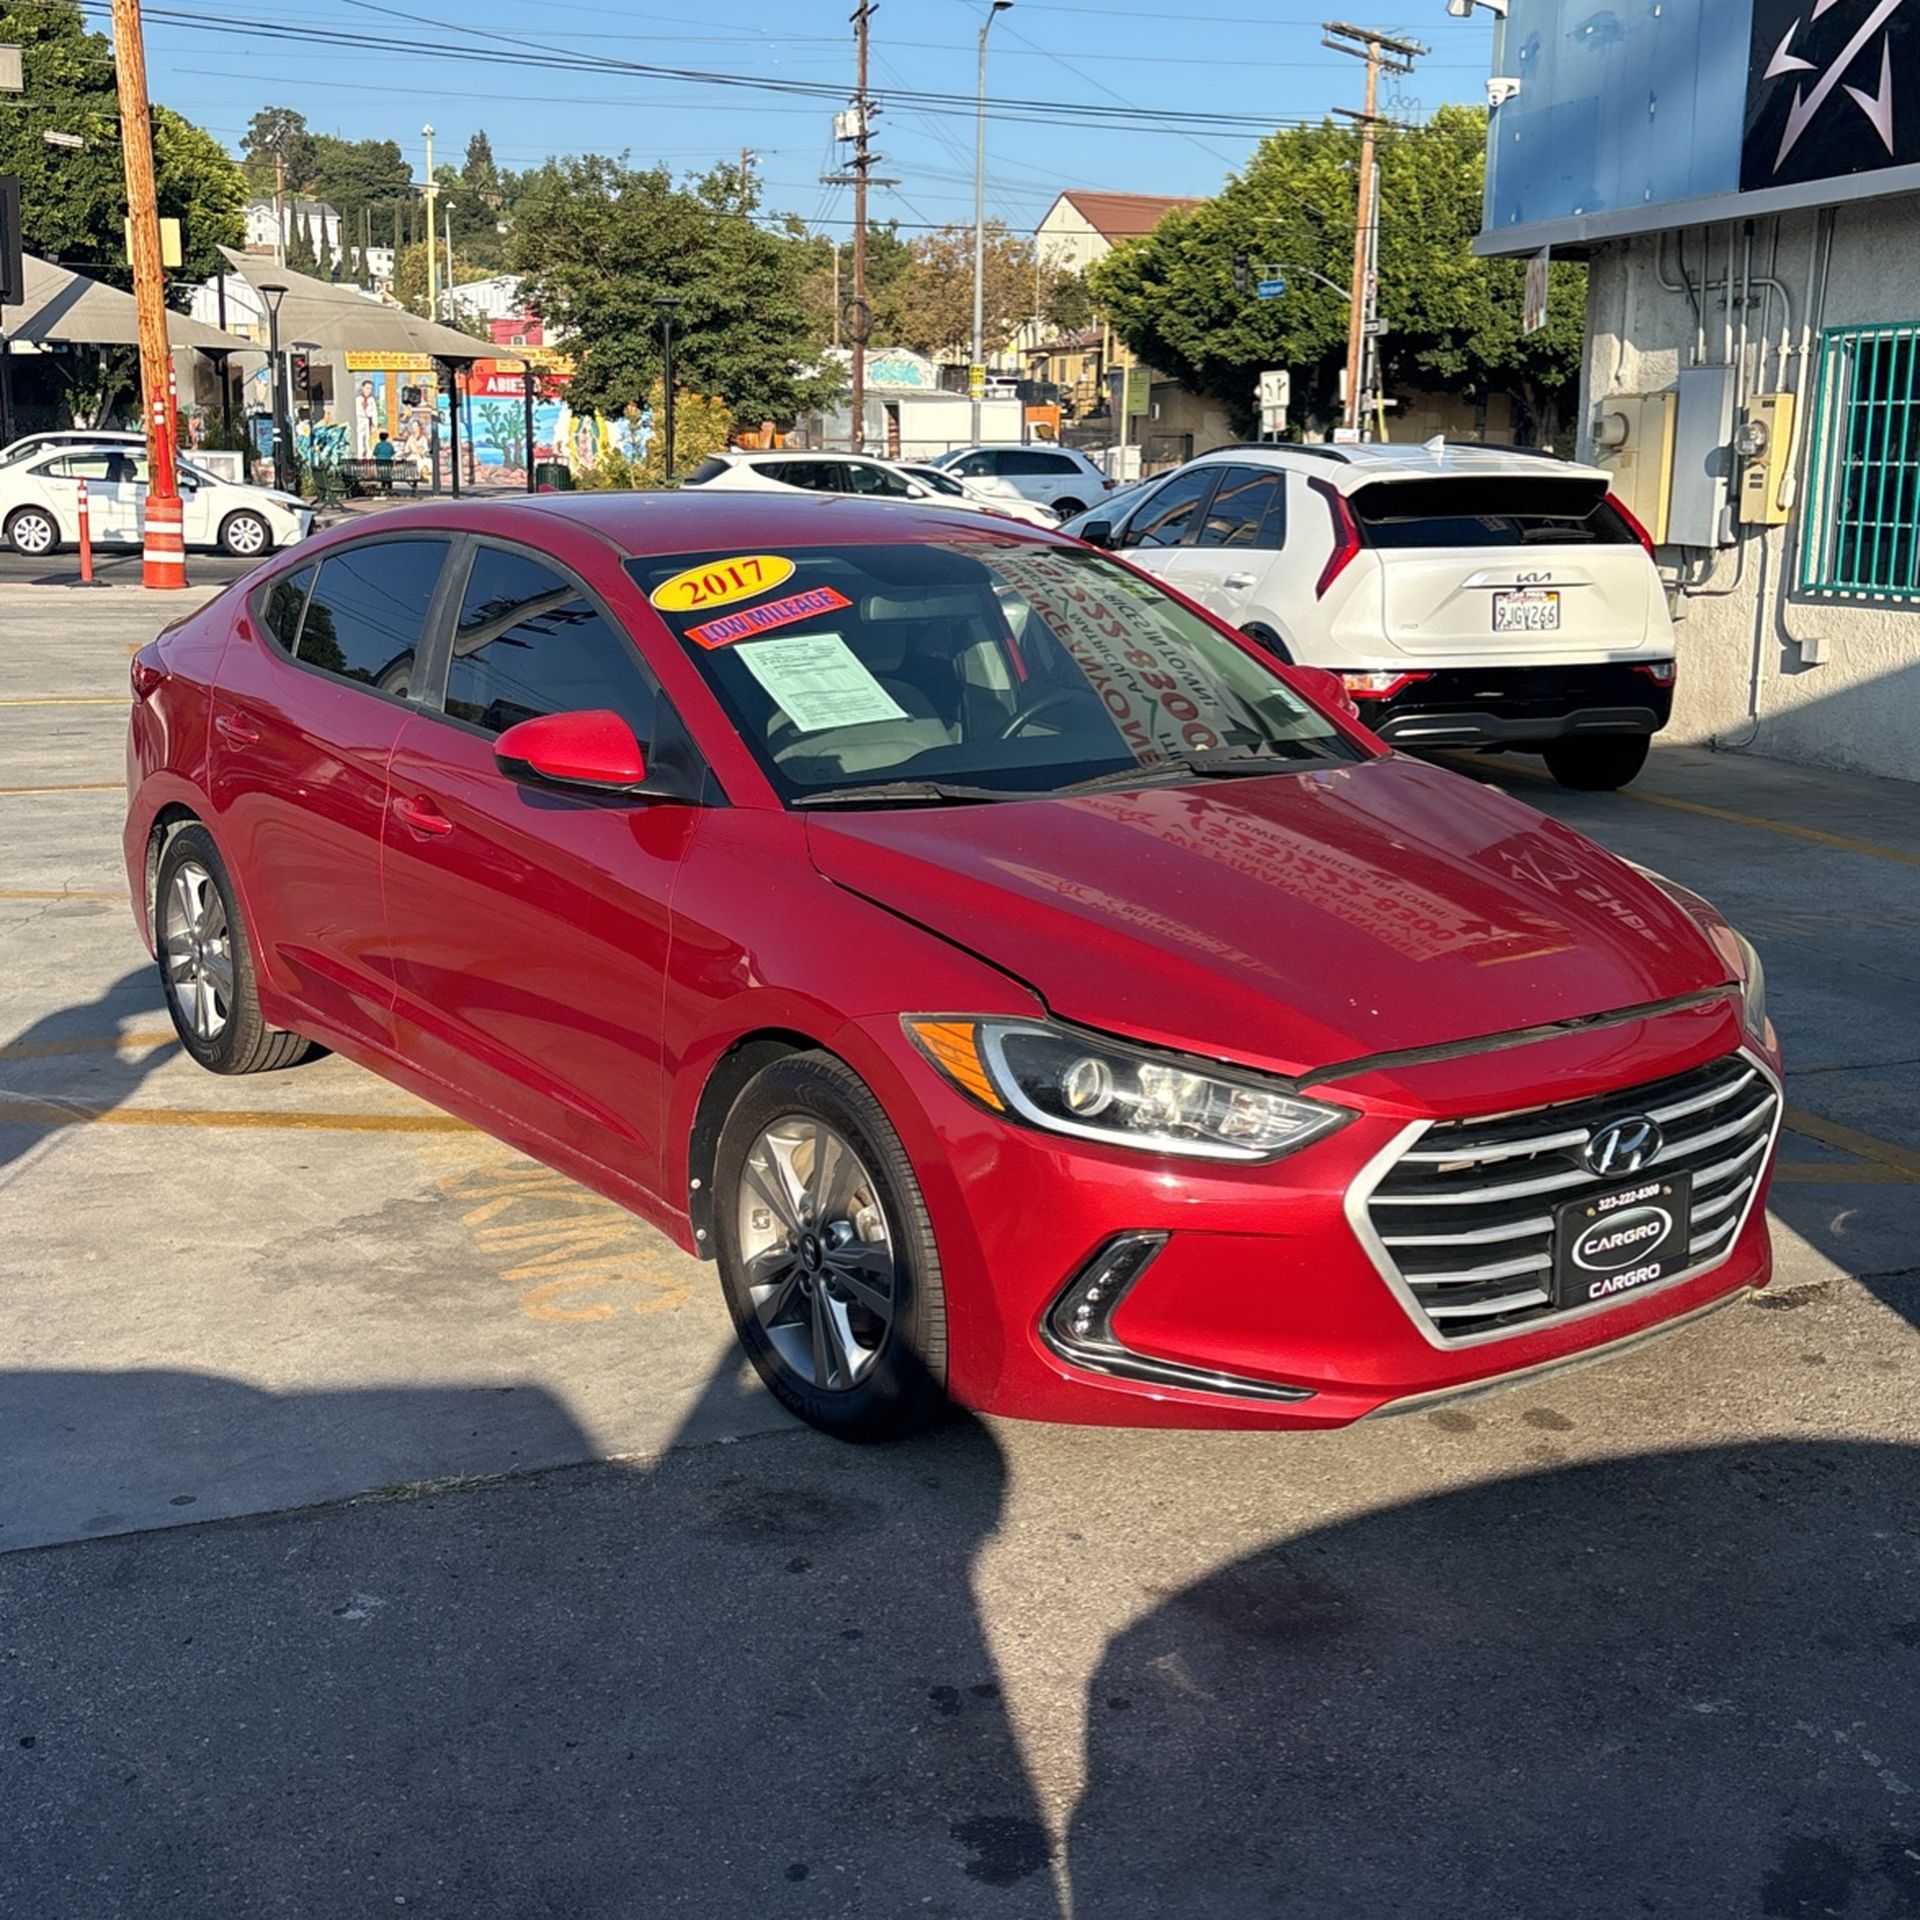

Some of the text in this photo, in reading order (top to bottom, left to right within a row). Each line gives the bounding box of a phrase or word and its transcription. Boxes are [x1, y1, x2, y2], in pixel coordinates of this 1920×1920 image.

[680, 559, 764, 605] 2017
[1516, 571, 1552, 582] KIA
[698, 591, 836, 643] LOW MILEAGE
[1498, 605, 1555, 626] 9JGV266
[1584, 1221, 1660, 1255] CARGRO
[1589, 1263, 1660, 1299] CARGRO
